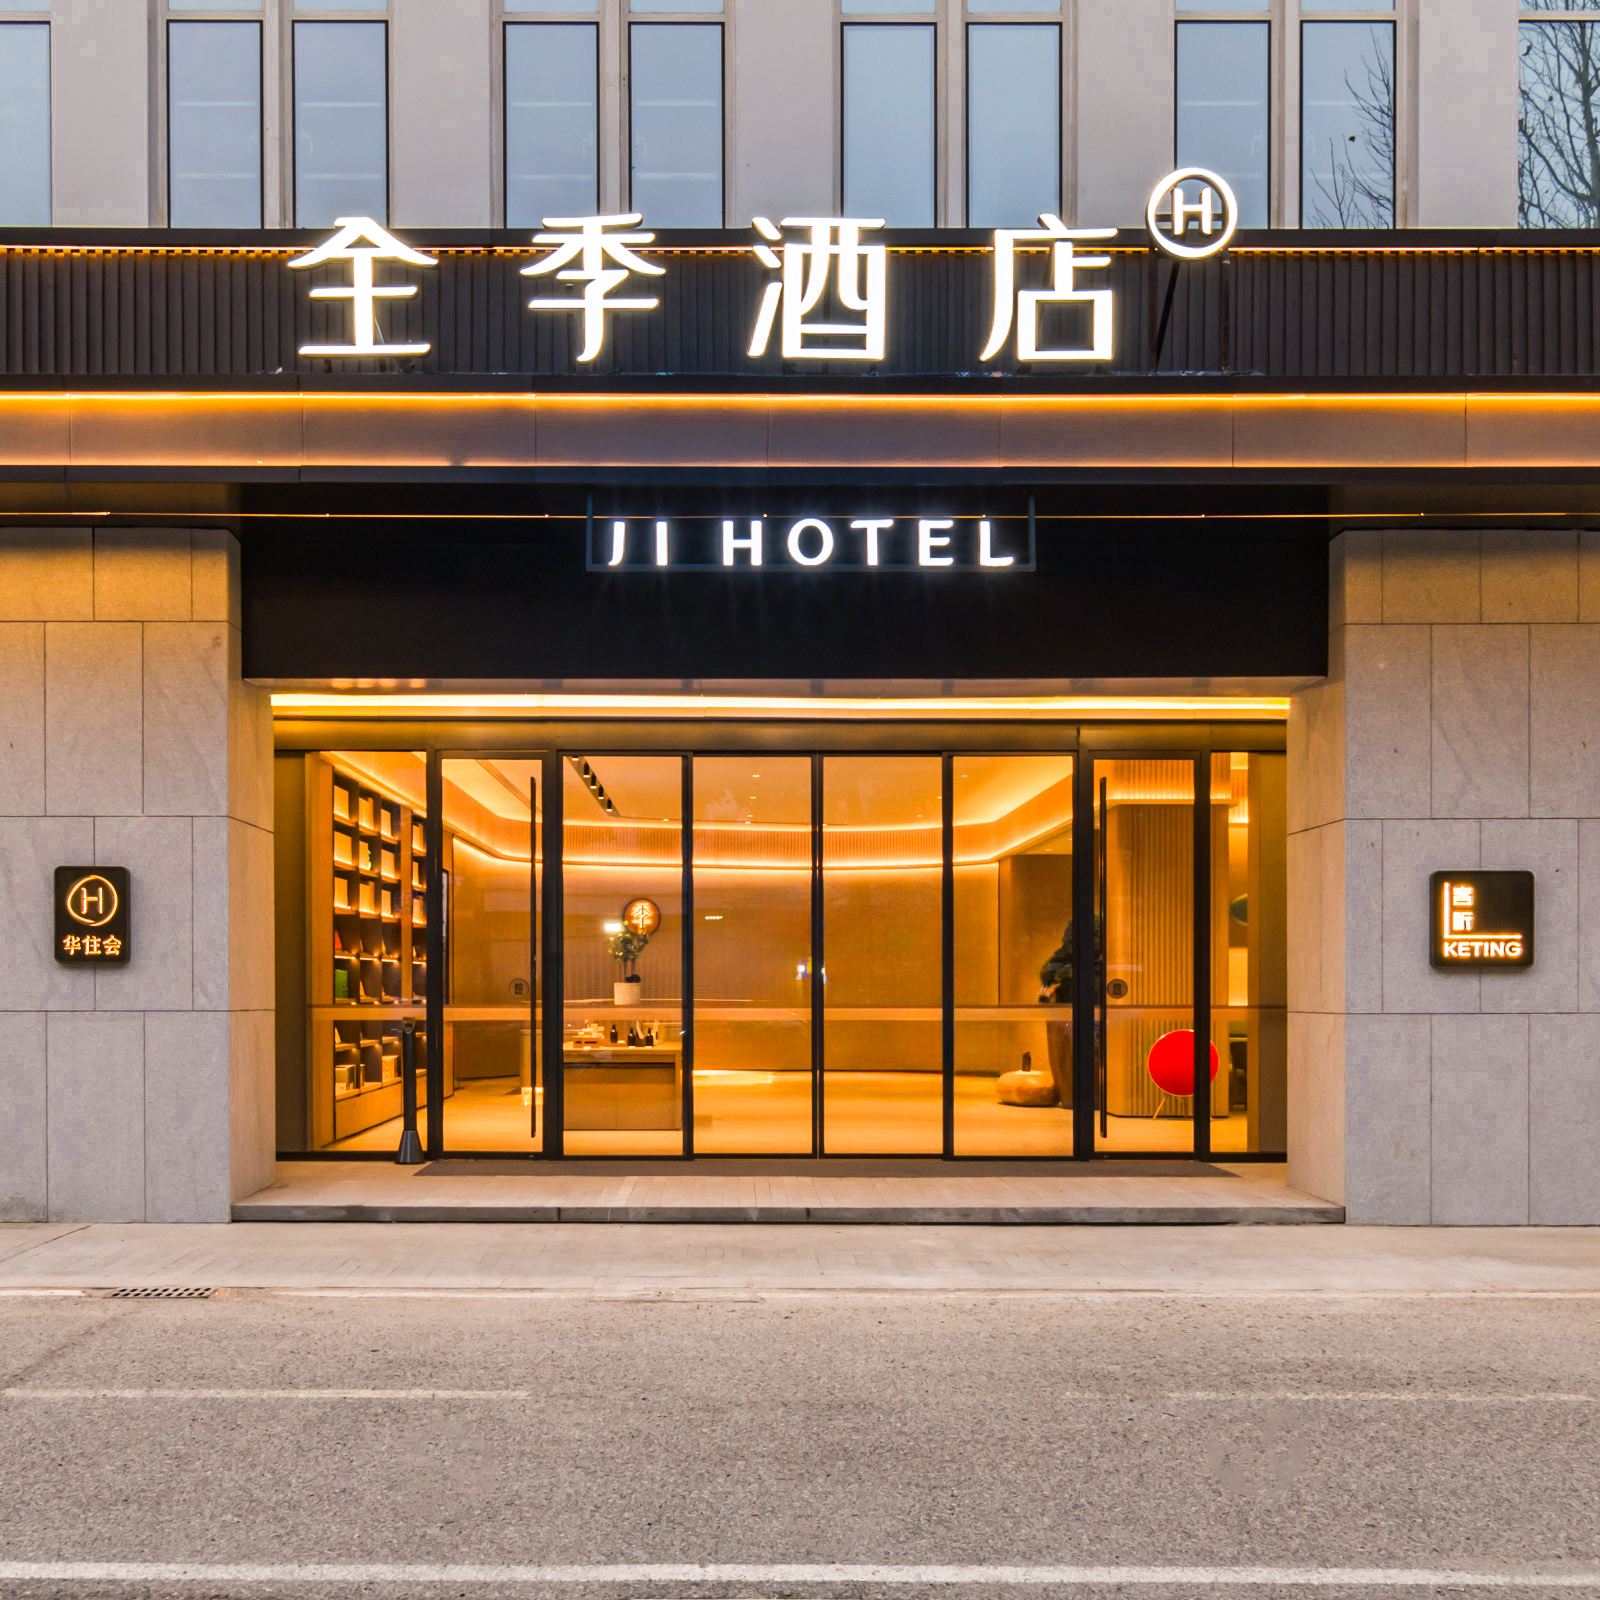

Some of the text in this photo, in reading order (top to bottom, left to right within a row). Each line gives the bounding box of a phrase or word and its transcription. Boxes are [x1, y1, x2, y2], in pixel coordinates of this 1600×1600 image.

[288, 213, 1120, 363] 全季酒店
[608, 518, 1014, 568] JI HOTEL
[62, 934, 122, 956] 华住会
[1443, 941, 1523, 957] KETING
